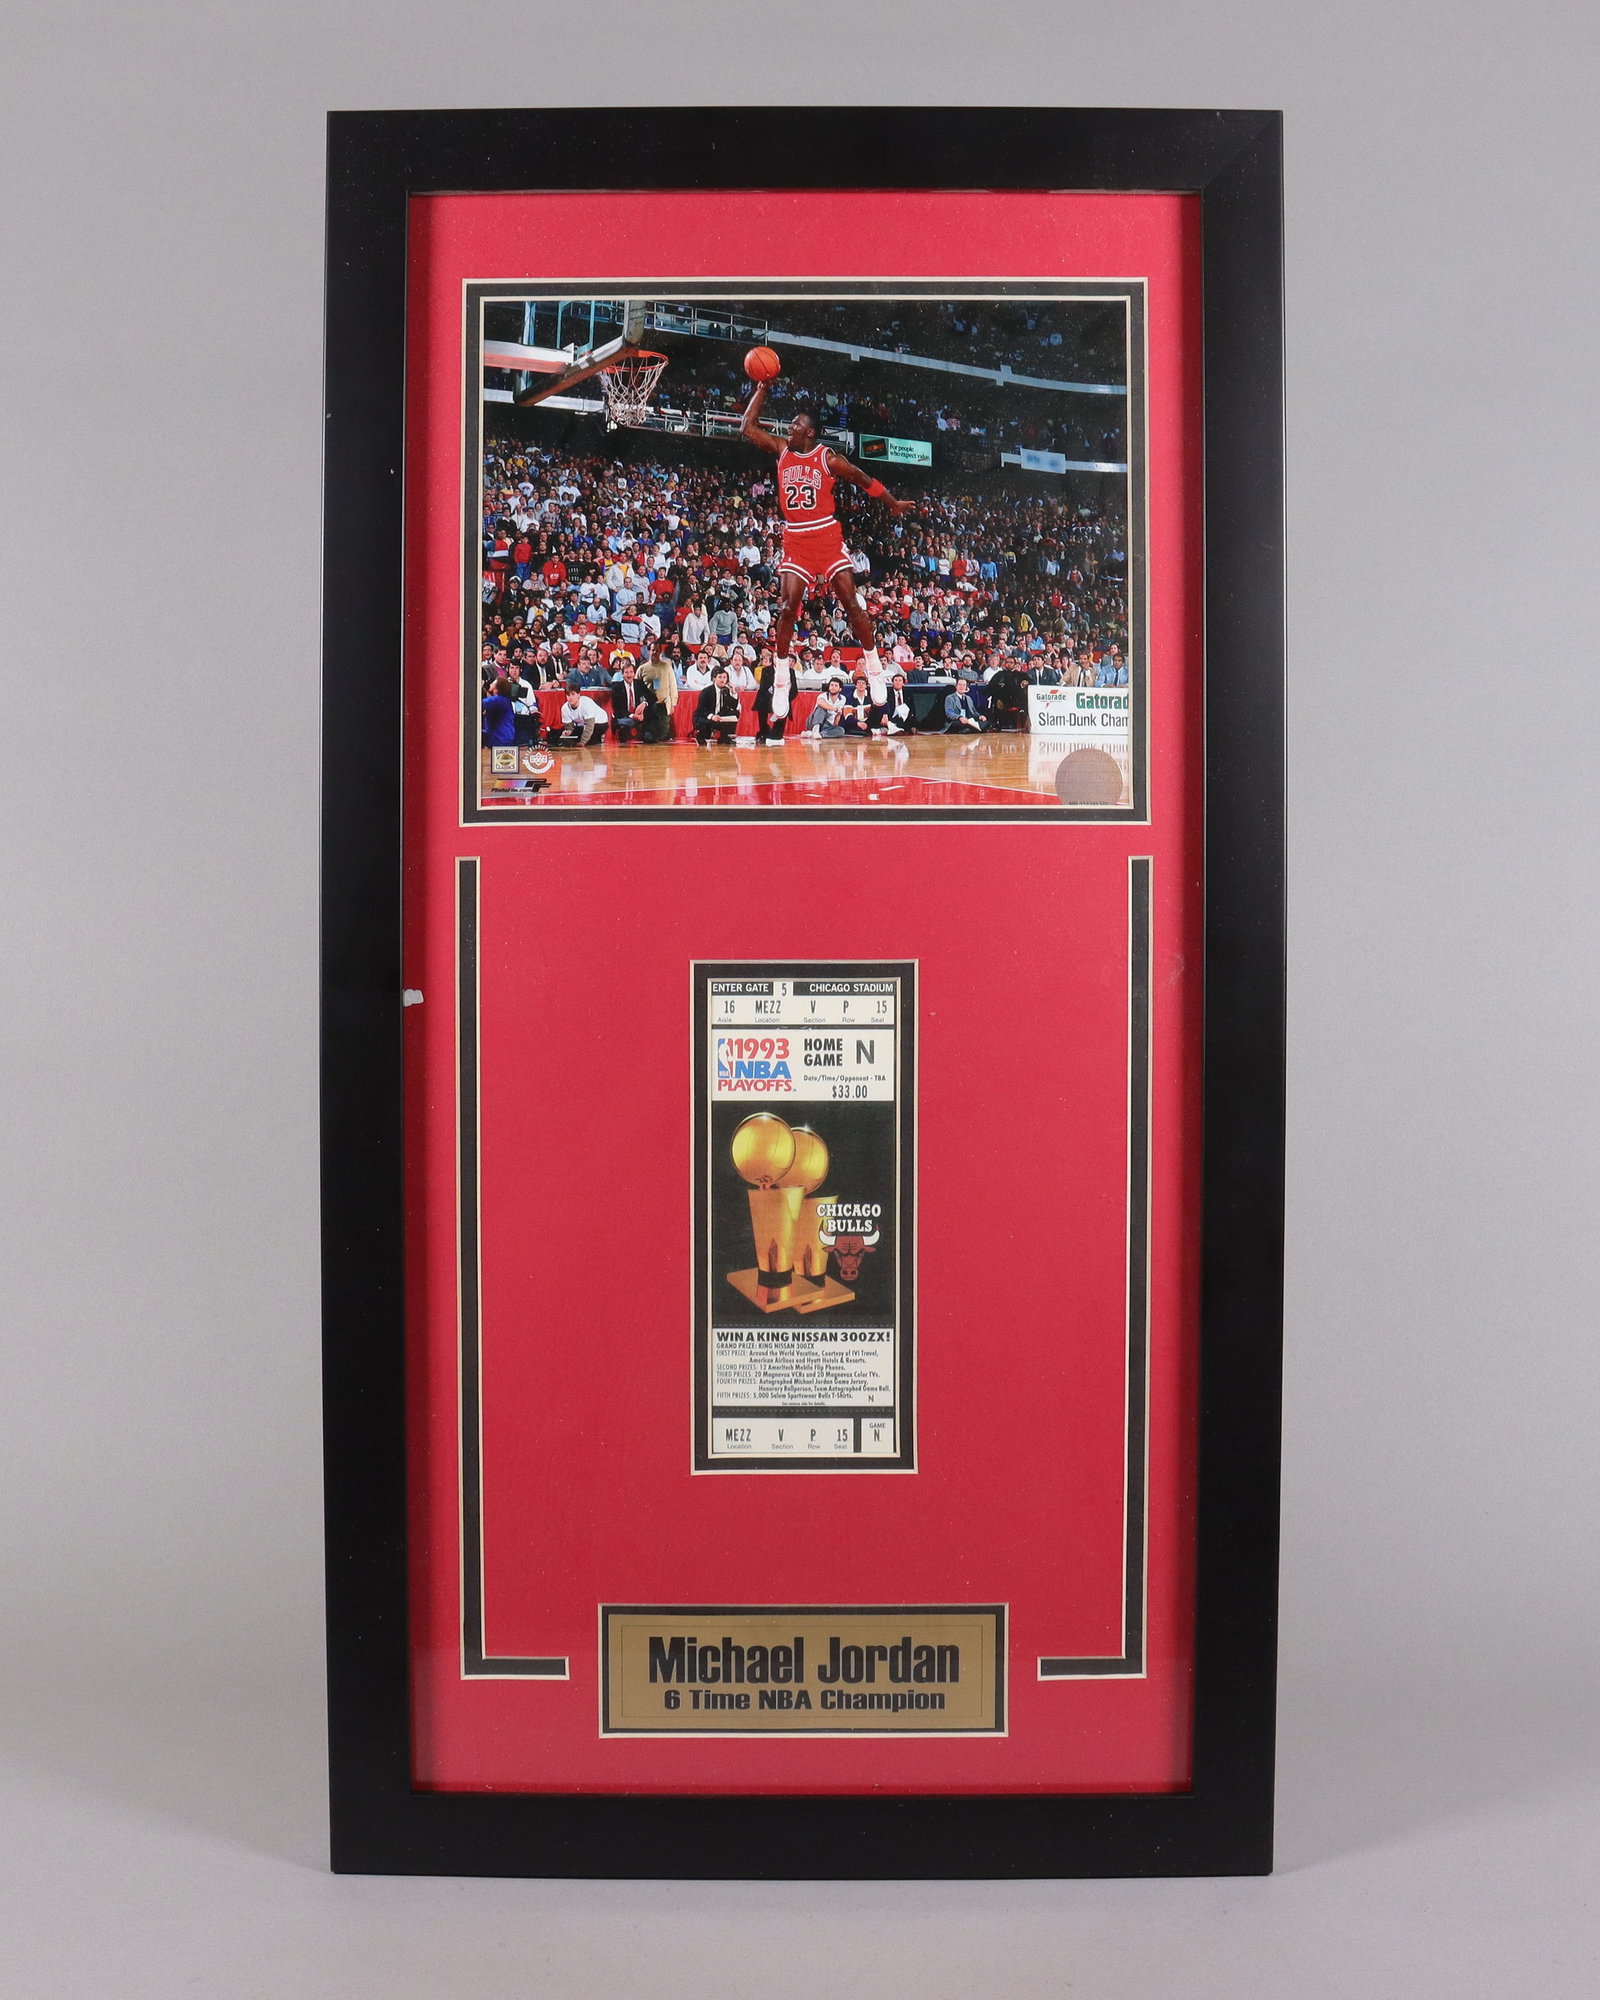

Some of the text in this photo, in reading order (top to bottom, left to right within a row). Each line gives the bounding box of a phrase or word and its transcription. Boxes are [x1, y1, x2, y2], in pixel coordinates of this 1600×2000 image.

[782, 465, 821, 490] BULLS
[785, 485, 817, 510] 23
[1039, 712, 1096, 726] Slam-Dunk
[713, 983, 787, 996] ENTER GATE 5
[810, 984, 893, 992] CHICAGO STADIUM
[724, 1000, 887, 1013] 16 MEZZ V P 15
[735, 1038, 789, 1059] 1993
[804, 1038, 843, 1051] HOME
[856, 1040, 874, 1064] N
[804, 1054, 843, 1066] GAME
[735, 1061, 792, 1078] NBA
[718, 1080, 792, 1091] PLAYOFFS
[832, 1085, 868, 1099] $33.00
[817, 1204, 881, 1217] CHICAGO
[827, 1220, 873, 1232] BULLS
[717, 1332, 890, 1342] WIN A KING NISSAN 300ZX!
[726, 1429, 848, 1441] MEZZ V P 15
[874, 1429, 880, 1441] N
[648, 1637, 960, 1684] Michael Jordan
[664, 1690, 946, 1712] 6 Time NBA Champion
